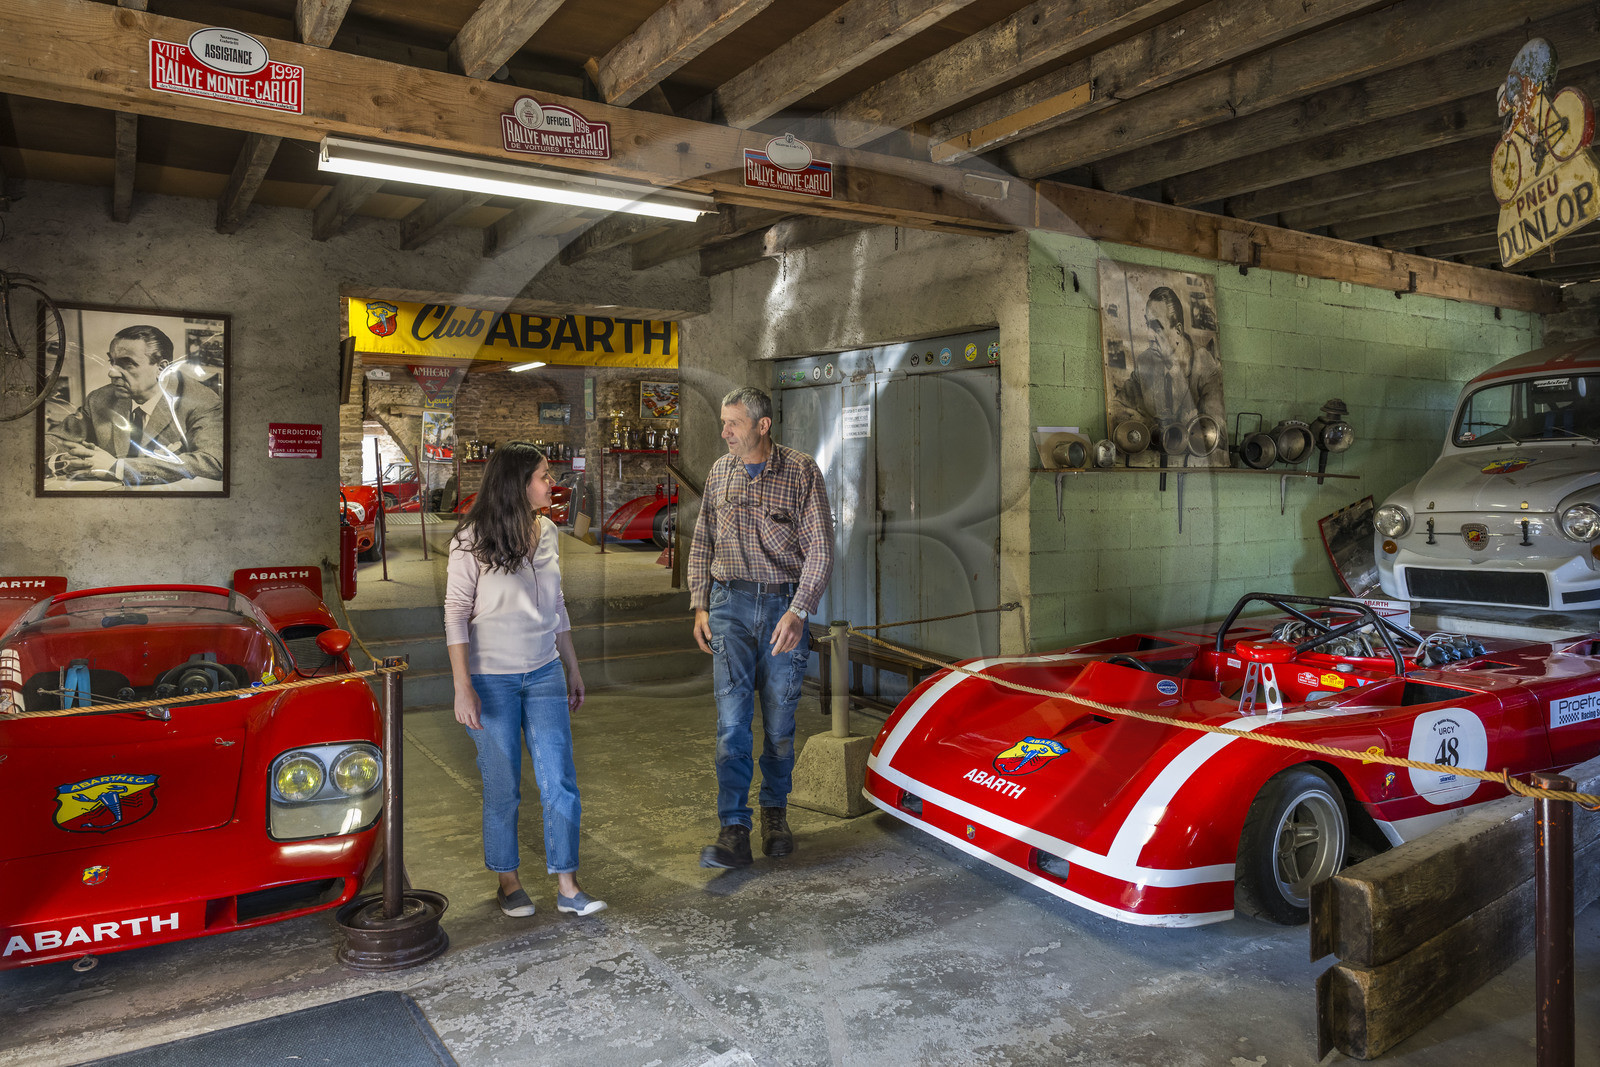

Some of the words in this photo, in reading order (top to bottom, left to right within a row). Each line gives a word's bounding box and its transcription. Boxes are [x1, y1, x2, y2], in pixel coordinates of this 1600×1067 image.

[205, 43, 252, 65] ASSISTANCE
[155, 52, 203, 90] RALLYE
[206, 73, 298, 105] MONTE-CARLO
[269, 64, 300, 80] 1992
[506, 119, 539, 145] RALLYE
[541, 129, 605, 150] MONTE-CARLO
[546, 115, 572, 127] OFFICIEL
[524, 145, 560, 153] VOITURES
[563, 147, 604, 157] ANCIENNES
[747, 159, 775, 184] RALLYE
[777, 171, 829, 192] MONTE-CARLO
[1516, 174, 1559, 218] PNEU
[1500, 181, 1594, 266] DUNLOP
[411, 302, 486, 342] Club
[484, 312, 671, 356] ABARTH
[249, 570, 309, 580] ABARTH
[1363, 600, 1389, 608] ABARTH
[1434, 737, 1459, 768] 48
[963, 768, 1027, 799] ABARTH
[2, 912, 179, 957] ABARTH
